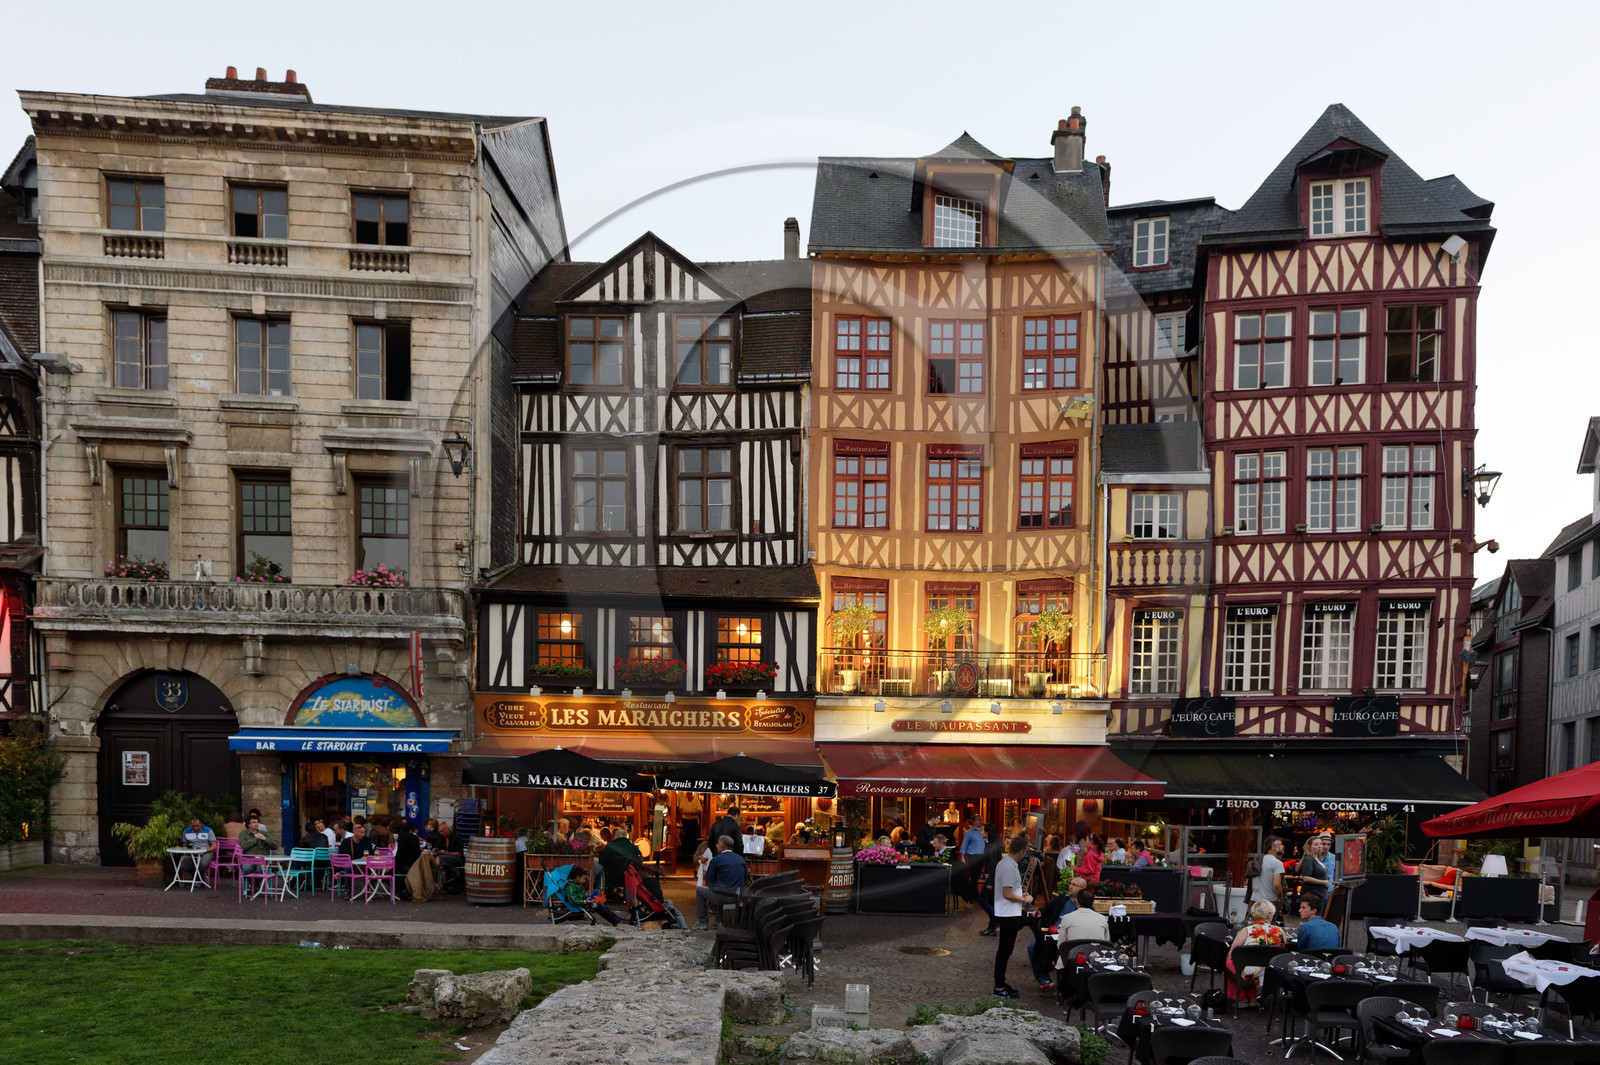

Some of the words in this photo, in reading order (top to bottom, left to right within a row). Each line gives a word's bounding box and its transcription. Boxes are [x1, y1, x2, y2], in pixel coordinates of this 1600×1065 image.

[162, 682, 182, 697] 33
[311, 696, 329, 712] LE
[333, 698, 391, 713] STARDUST
[623, 701, 671, 709] Restaurant
[551, 708, 589, 726] LES
[597, 709, 740, 727] MARAICHERS
[1171, 713, 1208, 722] L'EURO
[1209, 712, 1236, 721] CAFE
[1334, 712, 1370, 721] L'EURO
[1372, 711, 1399, 720] CAFE
[754, 720, 793, 728] BEAUJOLAIS
[907, 721, 922, 730] LE
[929, 721, 1018, 731] MAUPASSANT
[256, 742, 275, 750] BAR
[301, 741, 313, 750] LE
[316, 742, 367, 751] STARDUST
[392, 743, 422, 752] TABAC
[492, 772, 520, 784] LES
[527, 774, 628, 789] MARAICHERS
[664, 779, 692, 790] Depuis
[693, 780, 713, 790] 1912
[721, 781, 740, 791] LES
[742, 783, 810, 794] MARAICHERS
[817, 786, 828, 795] 37
[855, 782, 927, 794] Restaurant
[1076, 788, 1113, 796] Déjeuners
[1275, 800, 1306, 810] BARS
[1321, 801, 1388, 812] COCKTAILS
[1402, 804, 1416, 813] 41
[1475, 803, 1579, 825] Maupassant
